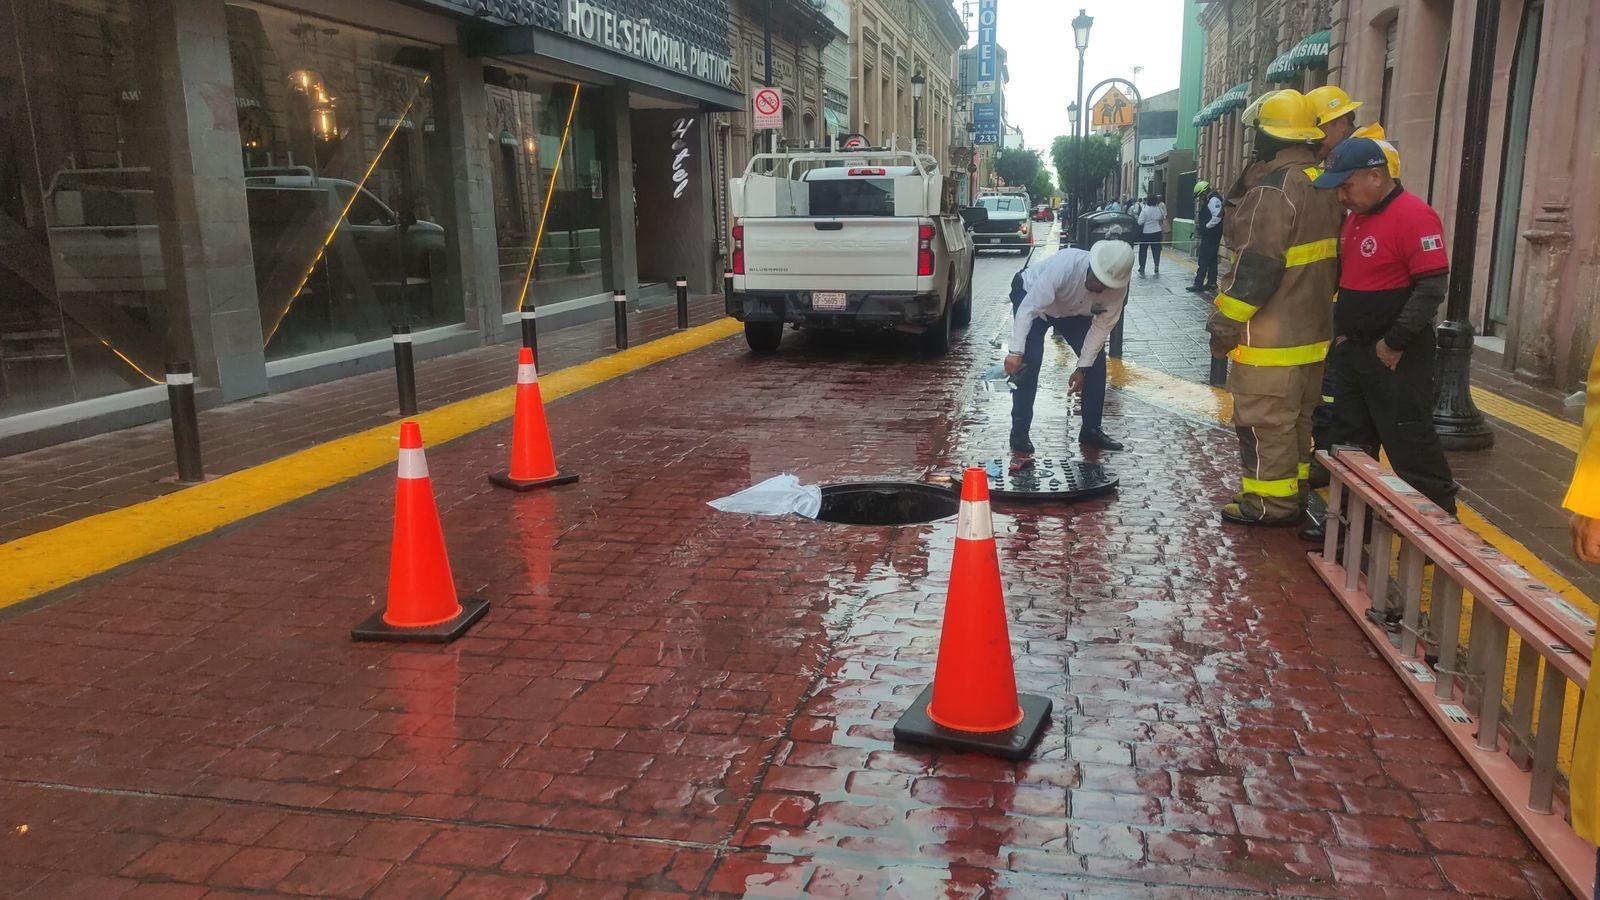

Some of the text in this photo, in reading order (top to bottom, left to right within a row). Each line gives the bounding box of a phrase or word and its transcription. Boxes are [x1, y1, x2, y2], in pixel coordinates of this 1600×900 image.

[567, 0, 732, 86] HOTEL SEÑORIAL PLATINO
[671, 118, 694, 199] Hotel
[979, 134, 997, 143] 233
